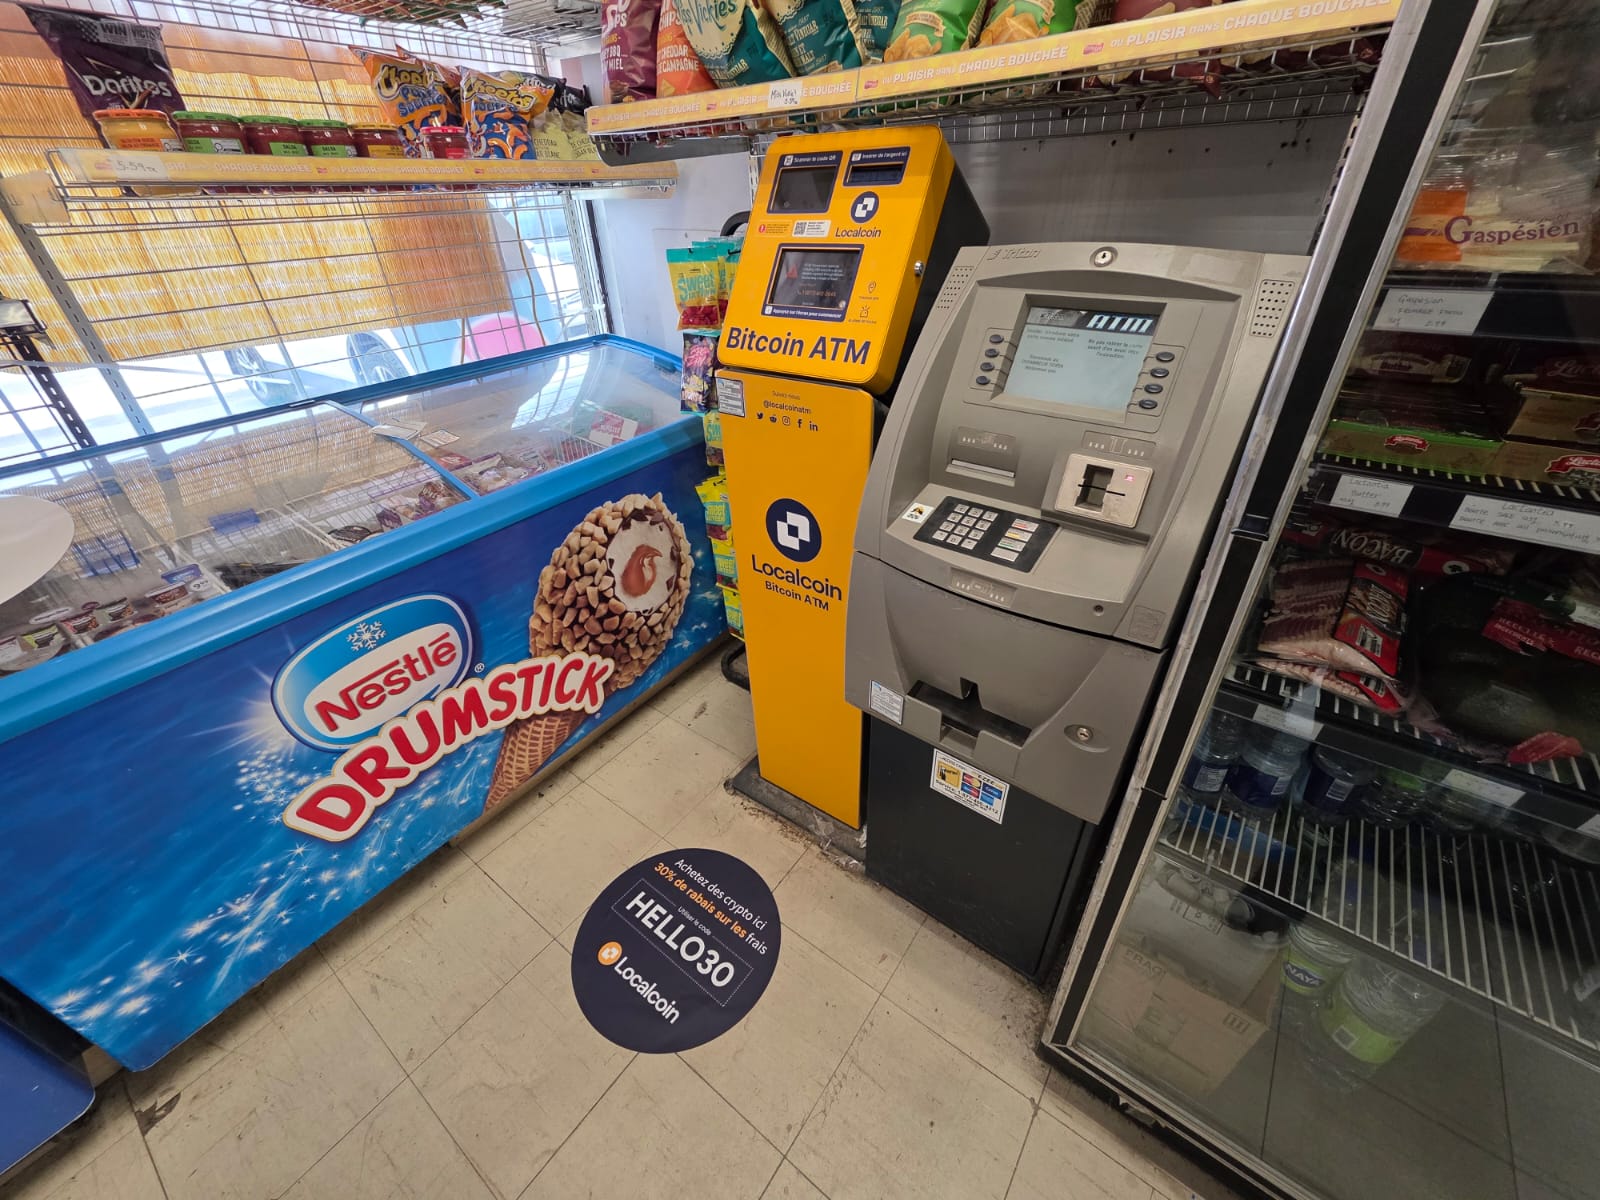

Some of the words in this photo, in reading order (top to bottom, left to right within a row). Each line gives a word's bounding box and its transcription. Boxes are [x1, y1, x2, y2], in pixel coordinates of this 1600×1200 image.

[101, 22, 127, 36] WIN
[1126, 26, 1187, 46] PLAISIR
[1189, 22, 1221, 34] DANS
[1223, 9, 1294, 31] CHAQUE
[662, 58, 699, 72] CAMPAGNE
[892, 68, 934, 84] PLAISIR
[958, 56, 1006, 74] CHAQUE
[1008, 45, 1069, 65] BOUCHÉE
[82, 74, 172, 97] Doritos
[810, 81, 852, 97] BOUCHÉE
[835, 226, 881, 238] Localcoin
[1444, 215, 1579, 245] Gaspésien
[1086, 313, 1153, 333] ATM
[726, 327, 805, 357] Bitcoin
[809, 336, 871, 365] ATM
[763, 400, 811, 415] @localcoinatm
[1332, 528, 1412, 563] BACON
[752, 554, 842, 601] Localcoin
[765, 580, 802, 601] Bitcoin
[804, 594, 829, 612] ATM
[315, 631, 457, 732] Nestlé
[295, 658, 609, 833] DRUMSTICK
[654, 862, 675, 882] 30%
[673, 878, 688, 892] de
[686, 887, 716, 914] rabais
[714, 909, 733, 926] sur
[730, 920, 748, 938] les
[744, 932, 768, 955] frais
[674, 858, 710, 888] Achetez
[707, 882, 725, 899] des
[722, 895, 754, 921] crypto
[751, 915, 768, 931] ici
[625, 891, 735, 988] HELLO30
[693, 918, 701, 926] le
[698, 922, 712, 936] code
[613, 956, 680, 1024] Localcoin
[1286, 963, 1325, 987] NAYA
